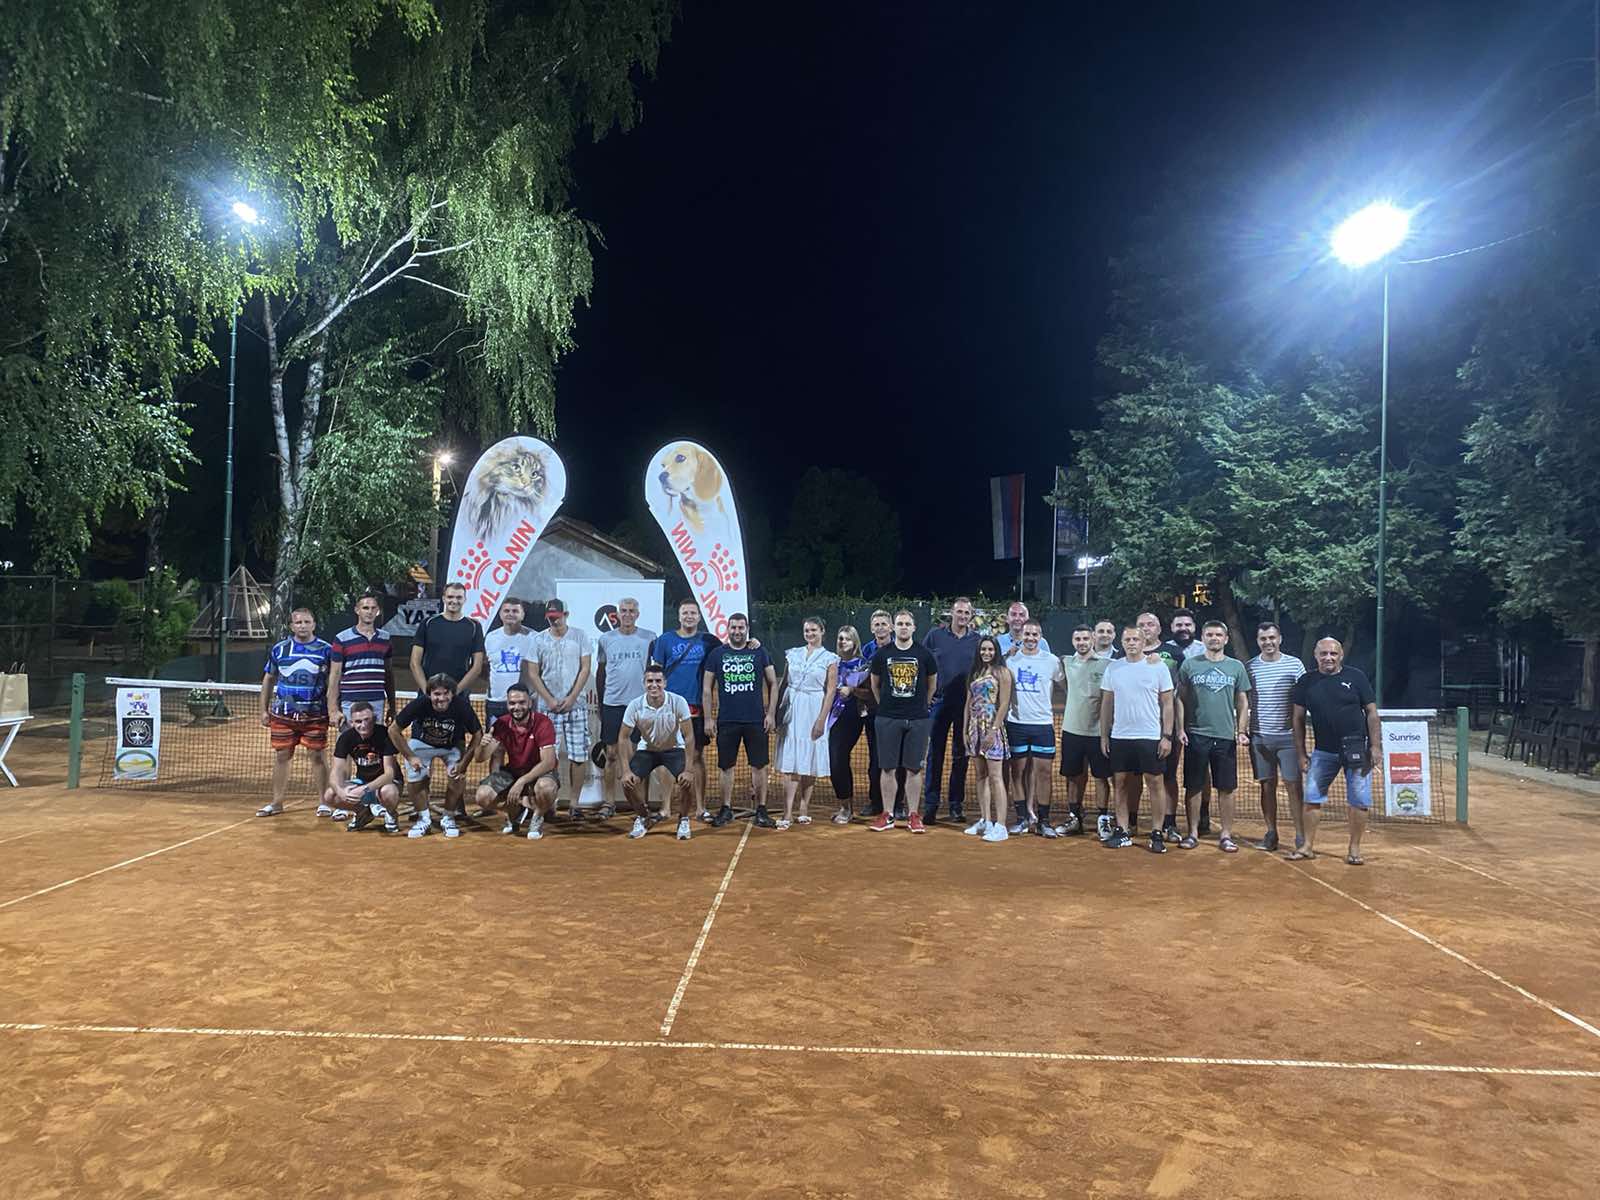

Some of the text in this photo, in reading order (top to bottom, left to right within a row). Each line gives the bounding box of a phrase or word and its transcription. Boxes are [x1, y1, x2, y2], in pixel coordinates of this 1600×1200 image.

[470, 519, 537, 620] YAL CANIN
[612, 651, 642, 660] TENIS
[723, 672, 756, 682] Street
[1193, 674, 1205, 684] LOS
[724, 681, 754, 694] Sport
[1388, 732, 1421, 742] Sunrise
